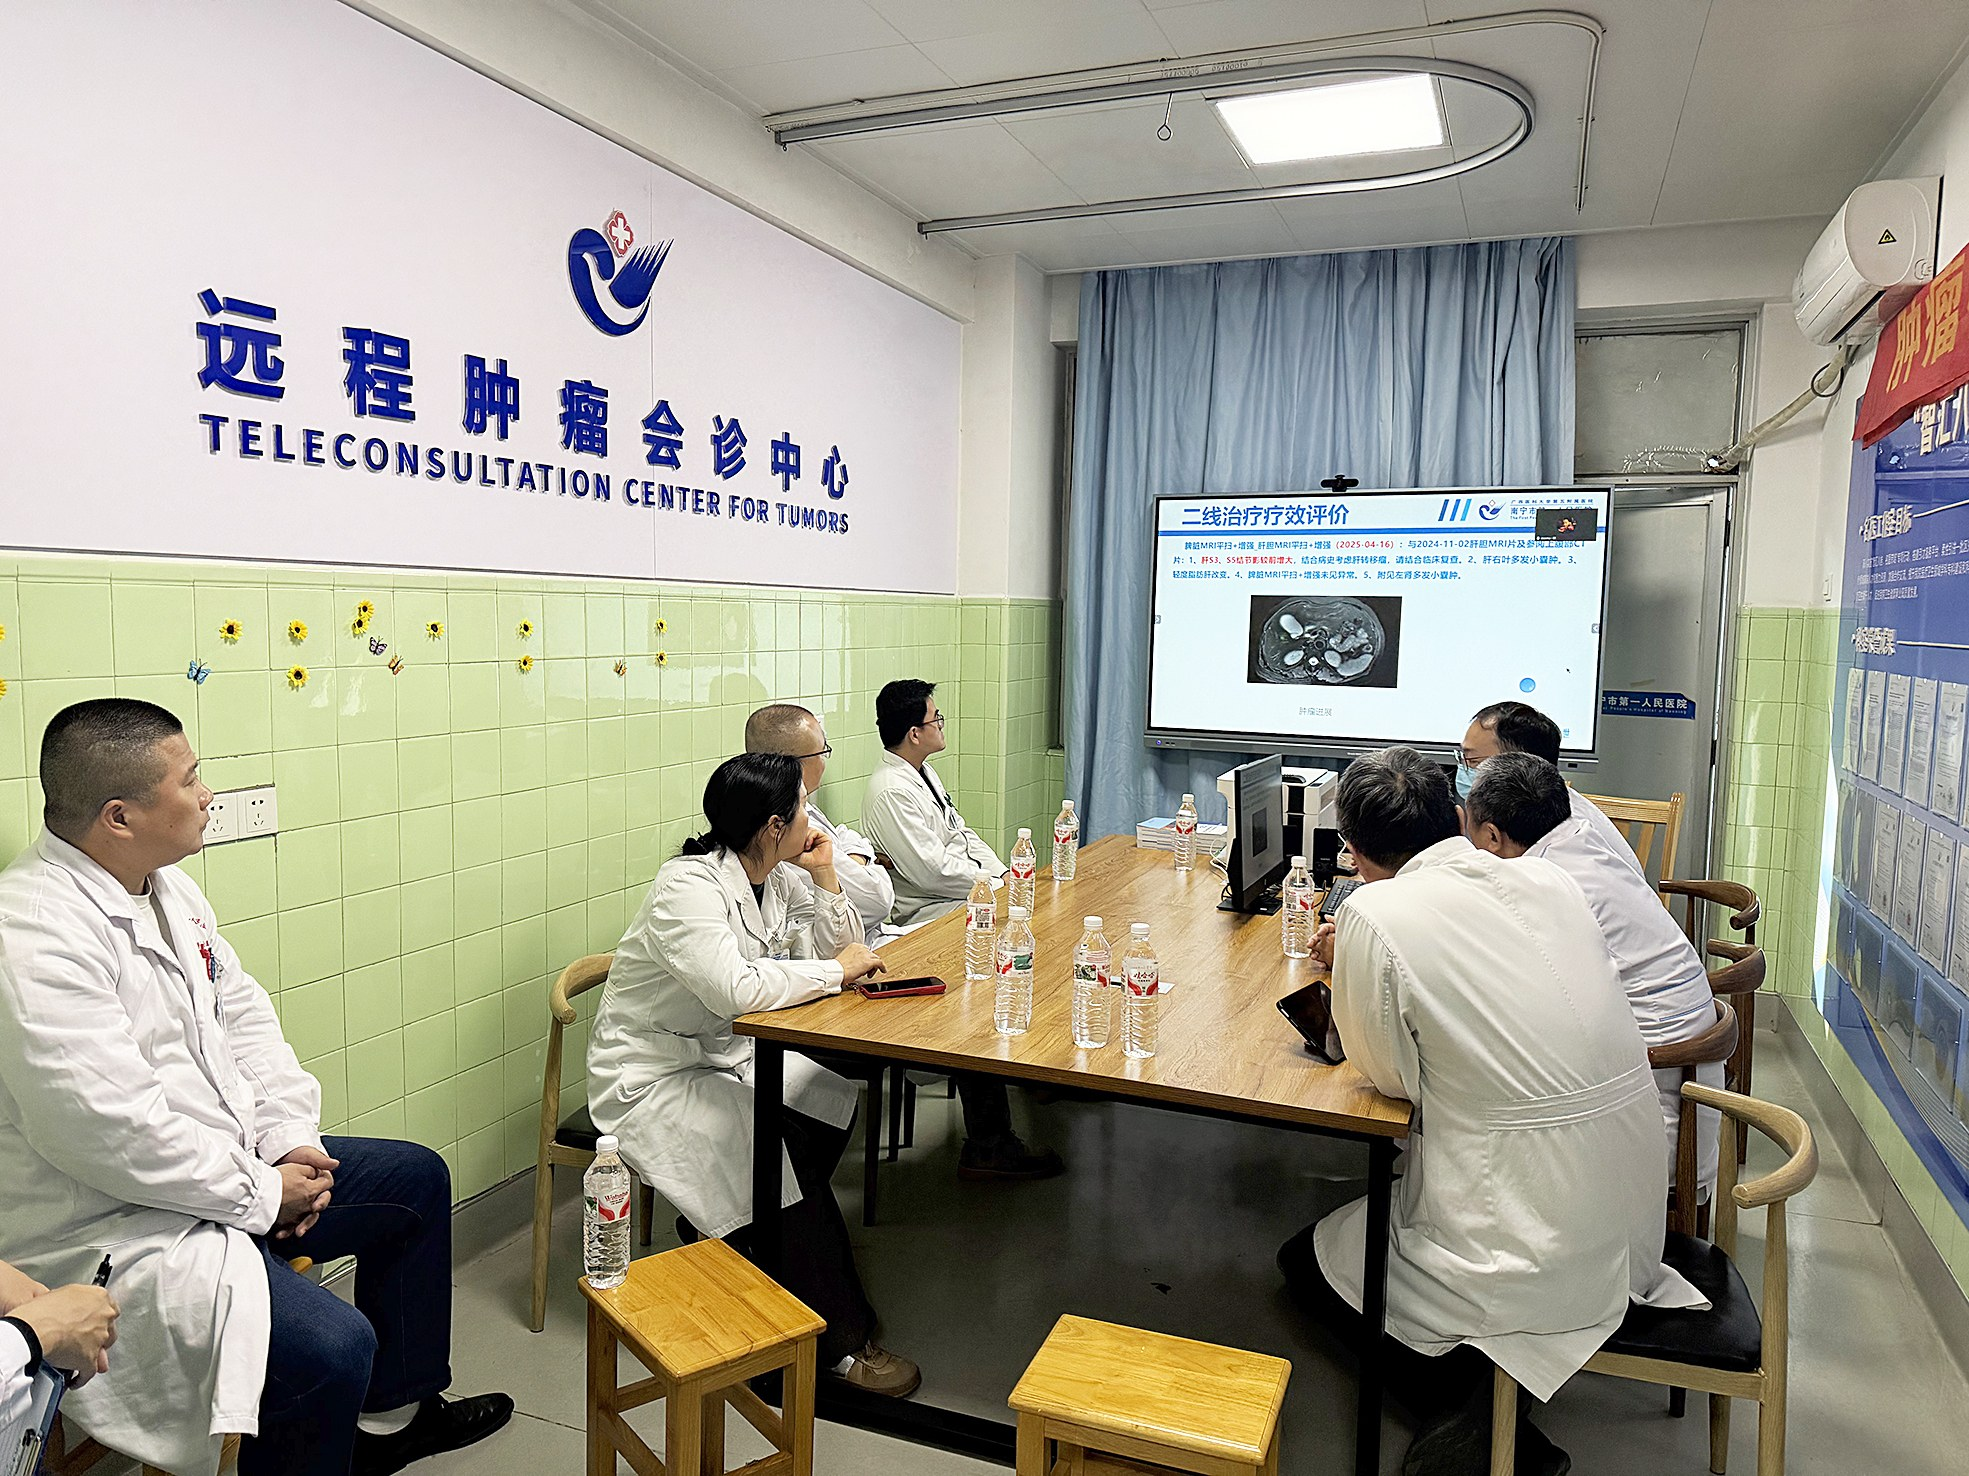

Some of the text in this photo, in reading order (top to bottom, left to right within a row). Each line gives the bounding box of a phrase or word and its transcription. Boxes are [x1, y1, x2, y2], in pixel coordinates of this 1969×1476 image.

[1885, 253, 1969, 394] 肿瘤
[195, 288, 850, 500] 远程肿瘤会诊中心
[198, 413, 849, 535] TELECONSULTATION CENTER FOR TUMORS
[1182, 503, 1350, 527] 二线治疗疗效评价
